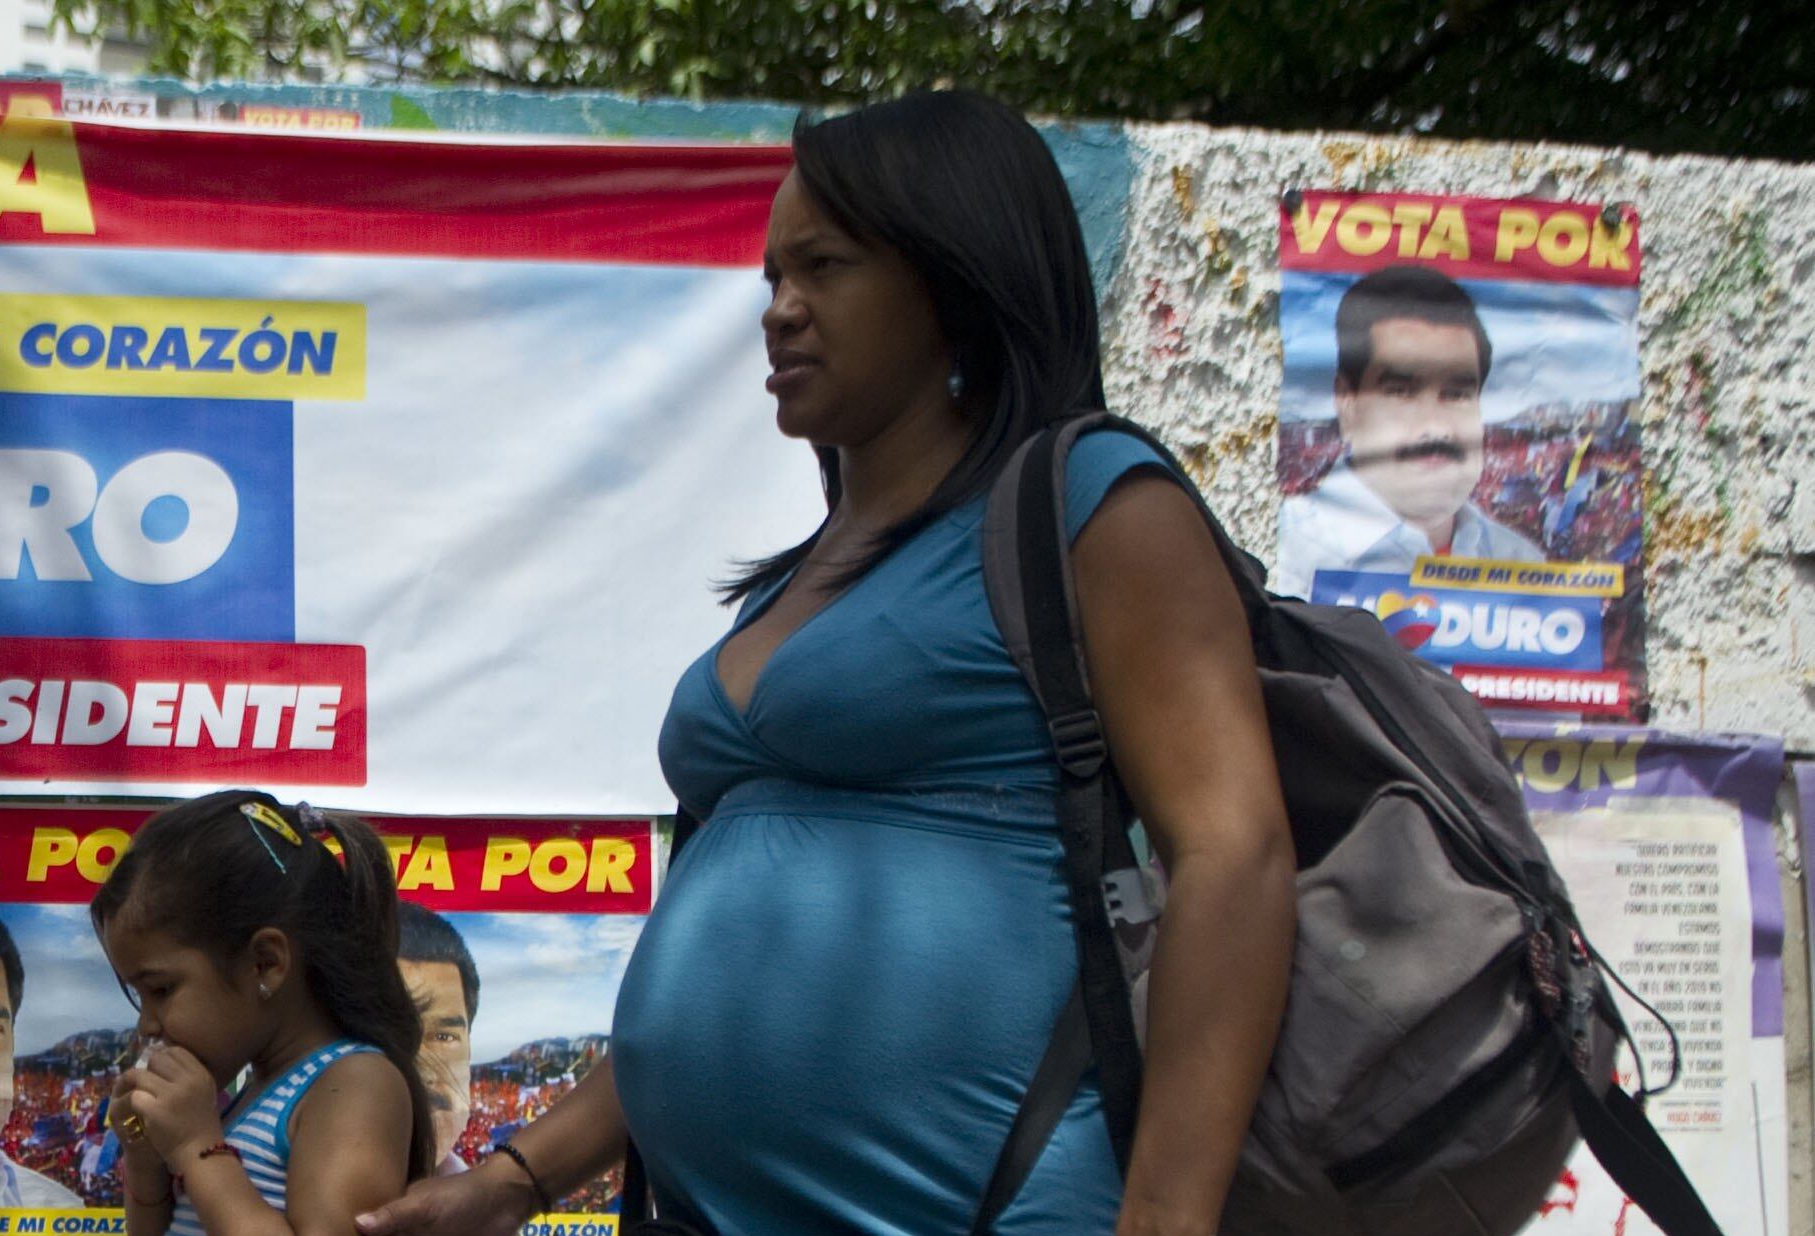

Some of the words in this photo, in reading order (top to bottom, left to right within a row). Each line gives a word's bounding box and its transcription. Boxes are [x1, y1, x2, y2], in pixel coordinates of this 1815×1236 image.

[1291, 200, 1470, 261] VOTA
[1495, 210, 1635, 272] POR
[20, 313, 338, 378] CORAZÓN
[1422, 563, 1481, 580] DESDE
[1486, 568, 1510, 583] MI
[1461, 675, 1620, 705] PRESIDENTE
[26, 827, 133, 884] PO
[384, 836, 455, 891] TA
[480, 837, 636, 893] POR
[19, 1217, 46, 1233] MI
[51, 1218, 124, 1234] CORAZ
